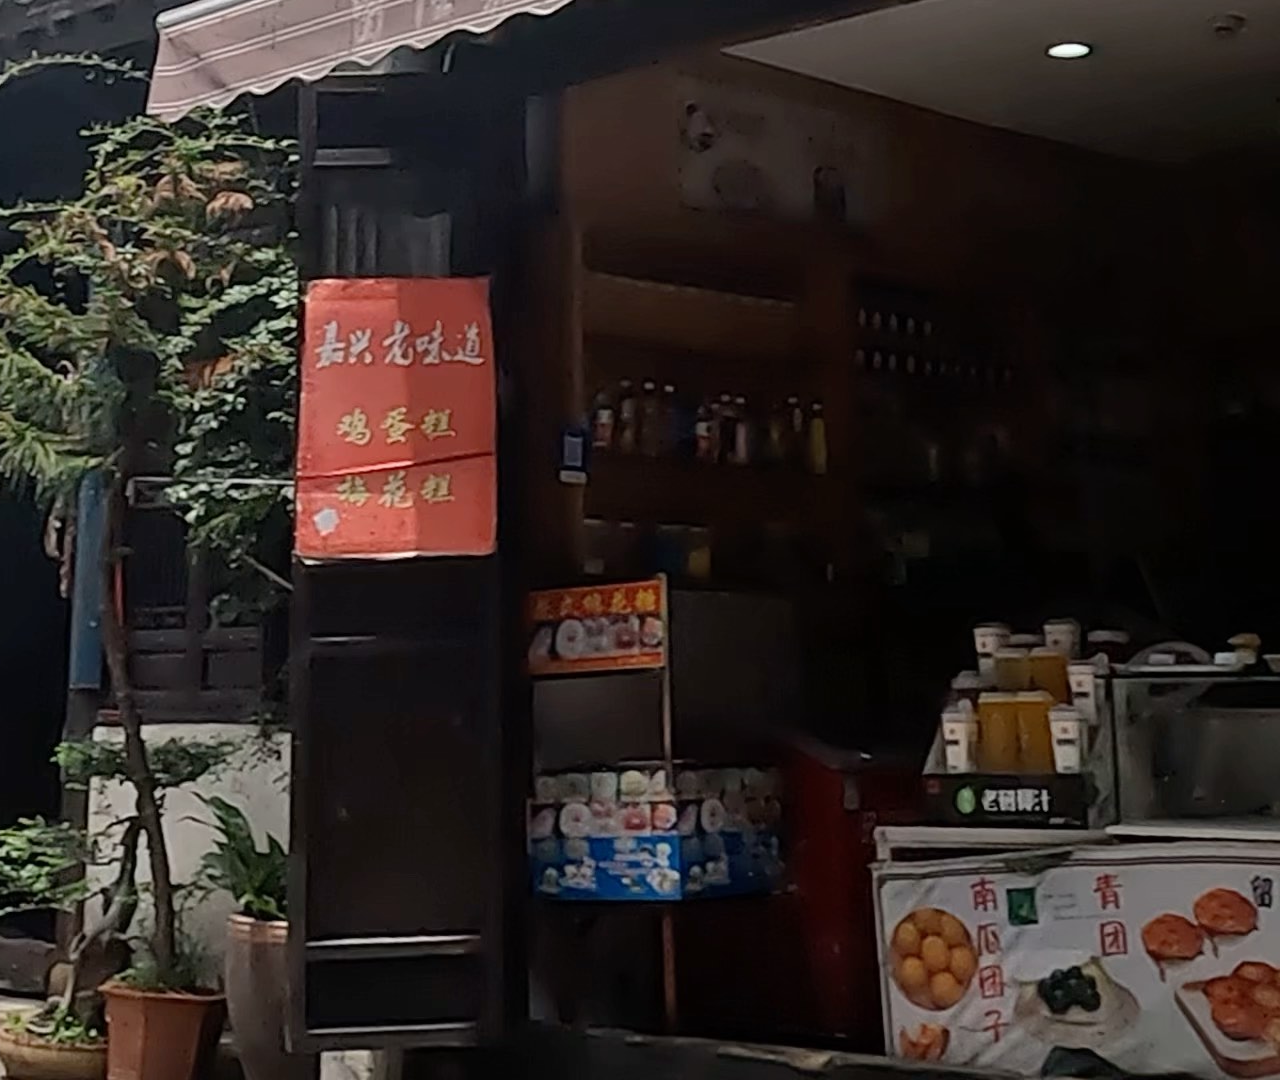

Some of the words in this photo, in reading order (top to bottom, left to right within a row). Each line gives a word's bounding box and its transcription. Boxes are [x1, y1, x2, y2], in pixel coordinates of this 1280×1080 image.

[314, 320, 486, 369] 嘉兴老味道
[336, 406, 456, 446] 鸡蛋糕
[1093, 873, 1128, 957] 青团
[970, 876, 1010, 1043] 南瓜团子
